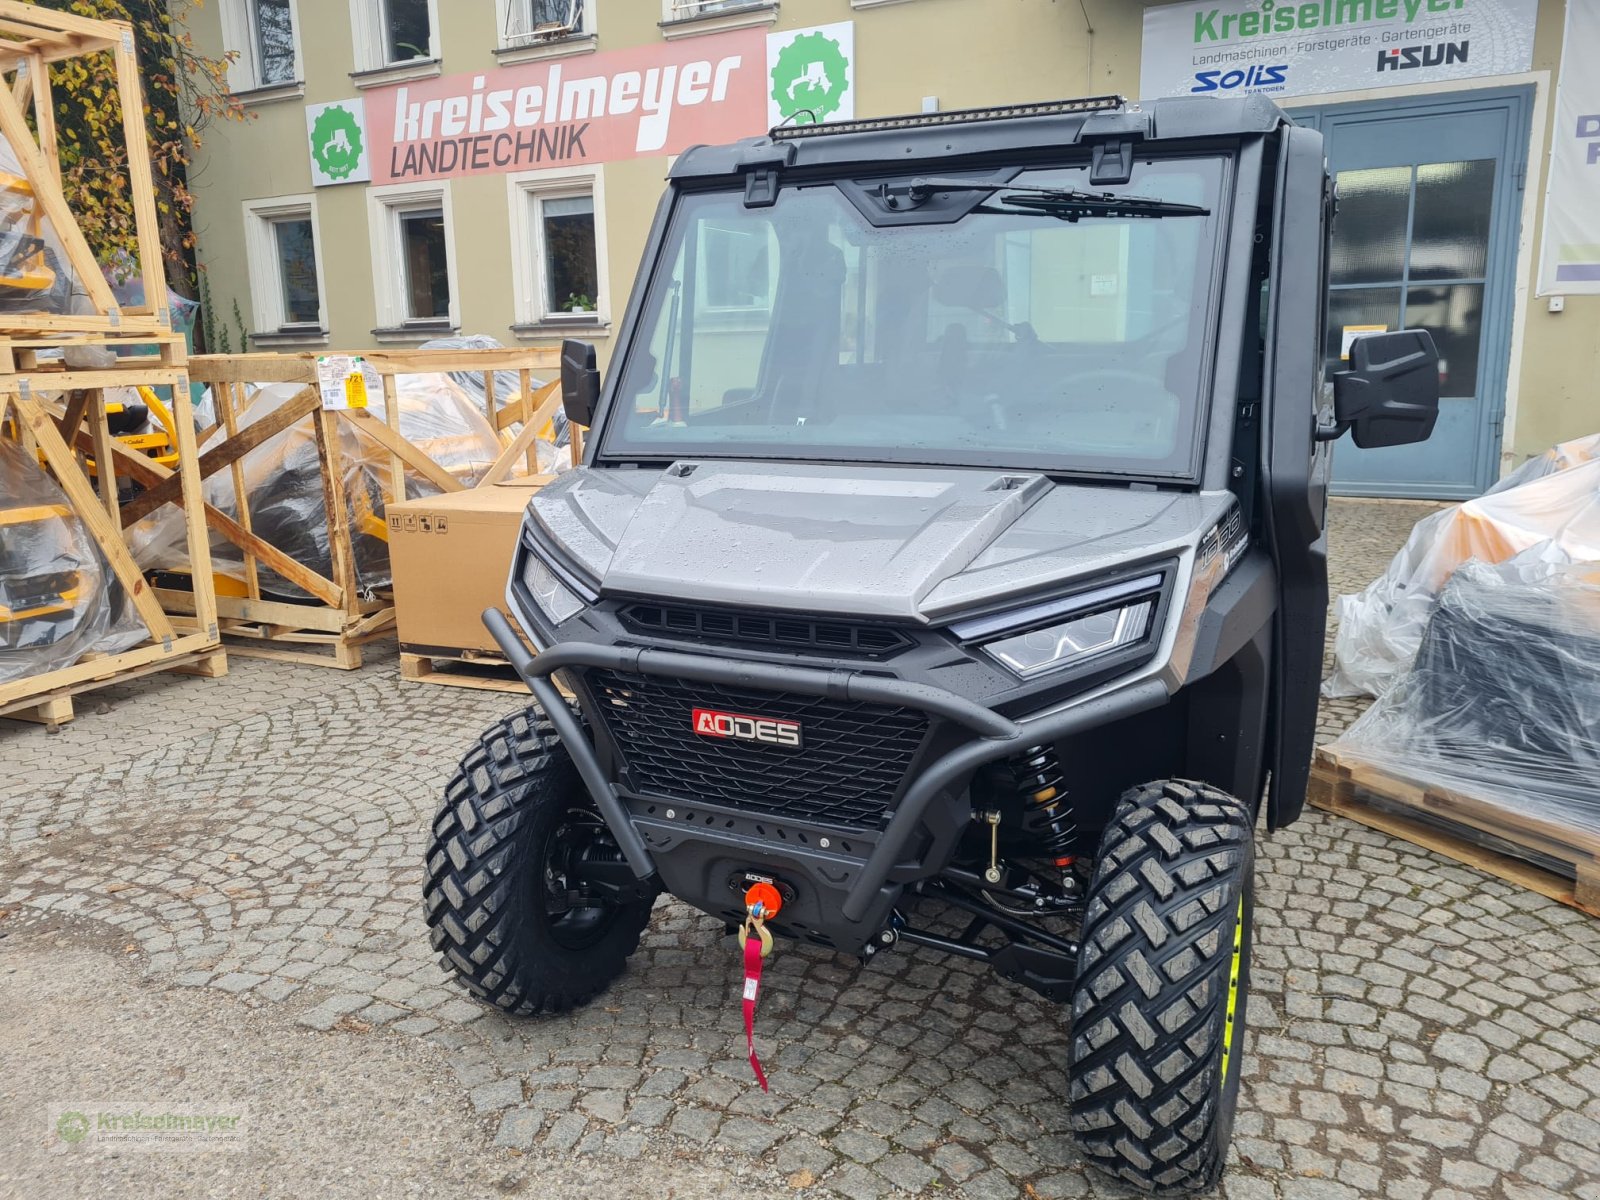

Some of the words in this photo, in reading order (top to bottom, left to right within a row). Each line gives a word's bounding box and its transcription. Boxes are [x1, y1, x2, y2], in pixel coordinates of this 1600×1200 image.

[1192, 46, 1287, 66] Landmaschinen
[1297, 35, 1371, 53] Forstgeräte
[1382, 23, 1471, 43] Gartengeräte
[393, 56, 742, 152] kreiselmeyer
[390, 122, 590, 178] LANDTECHNIK
[697, 712, 799, 745] AODES
